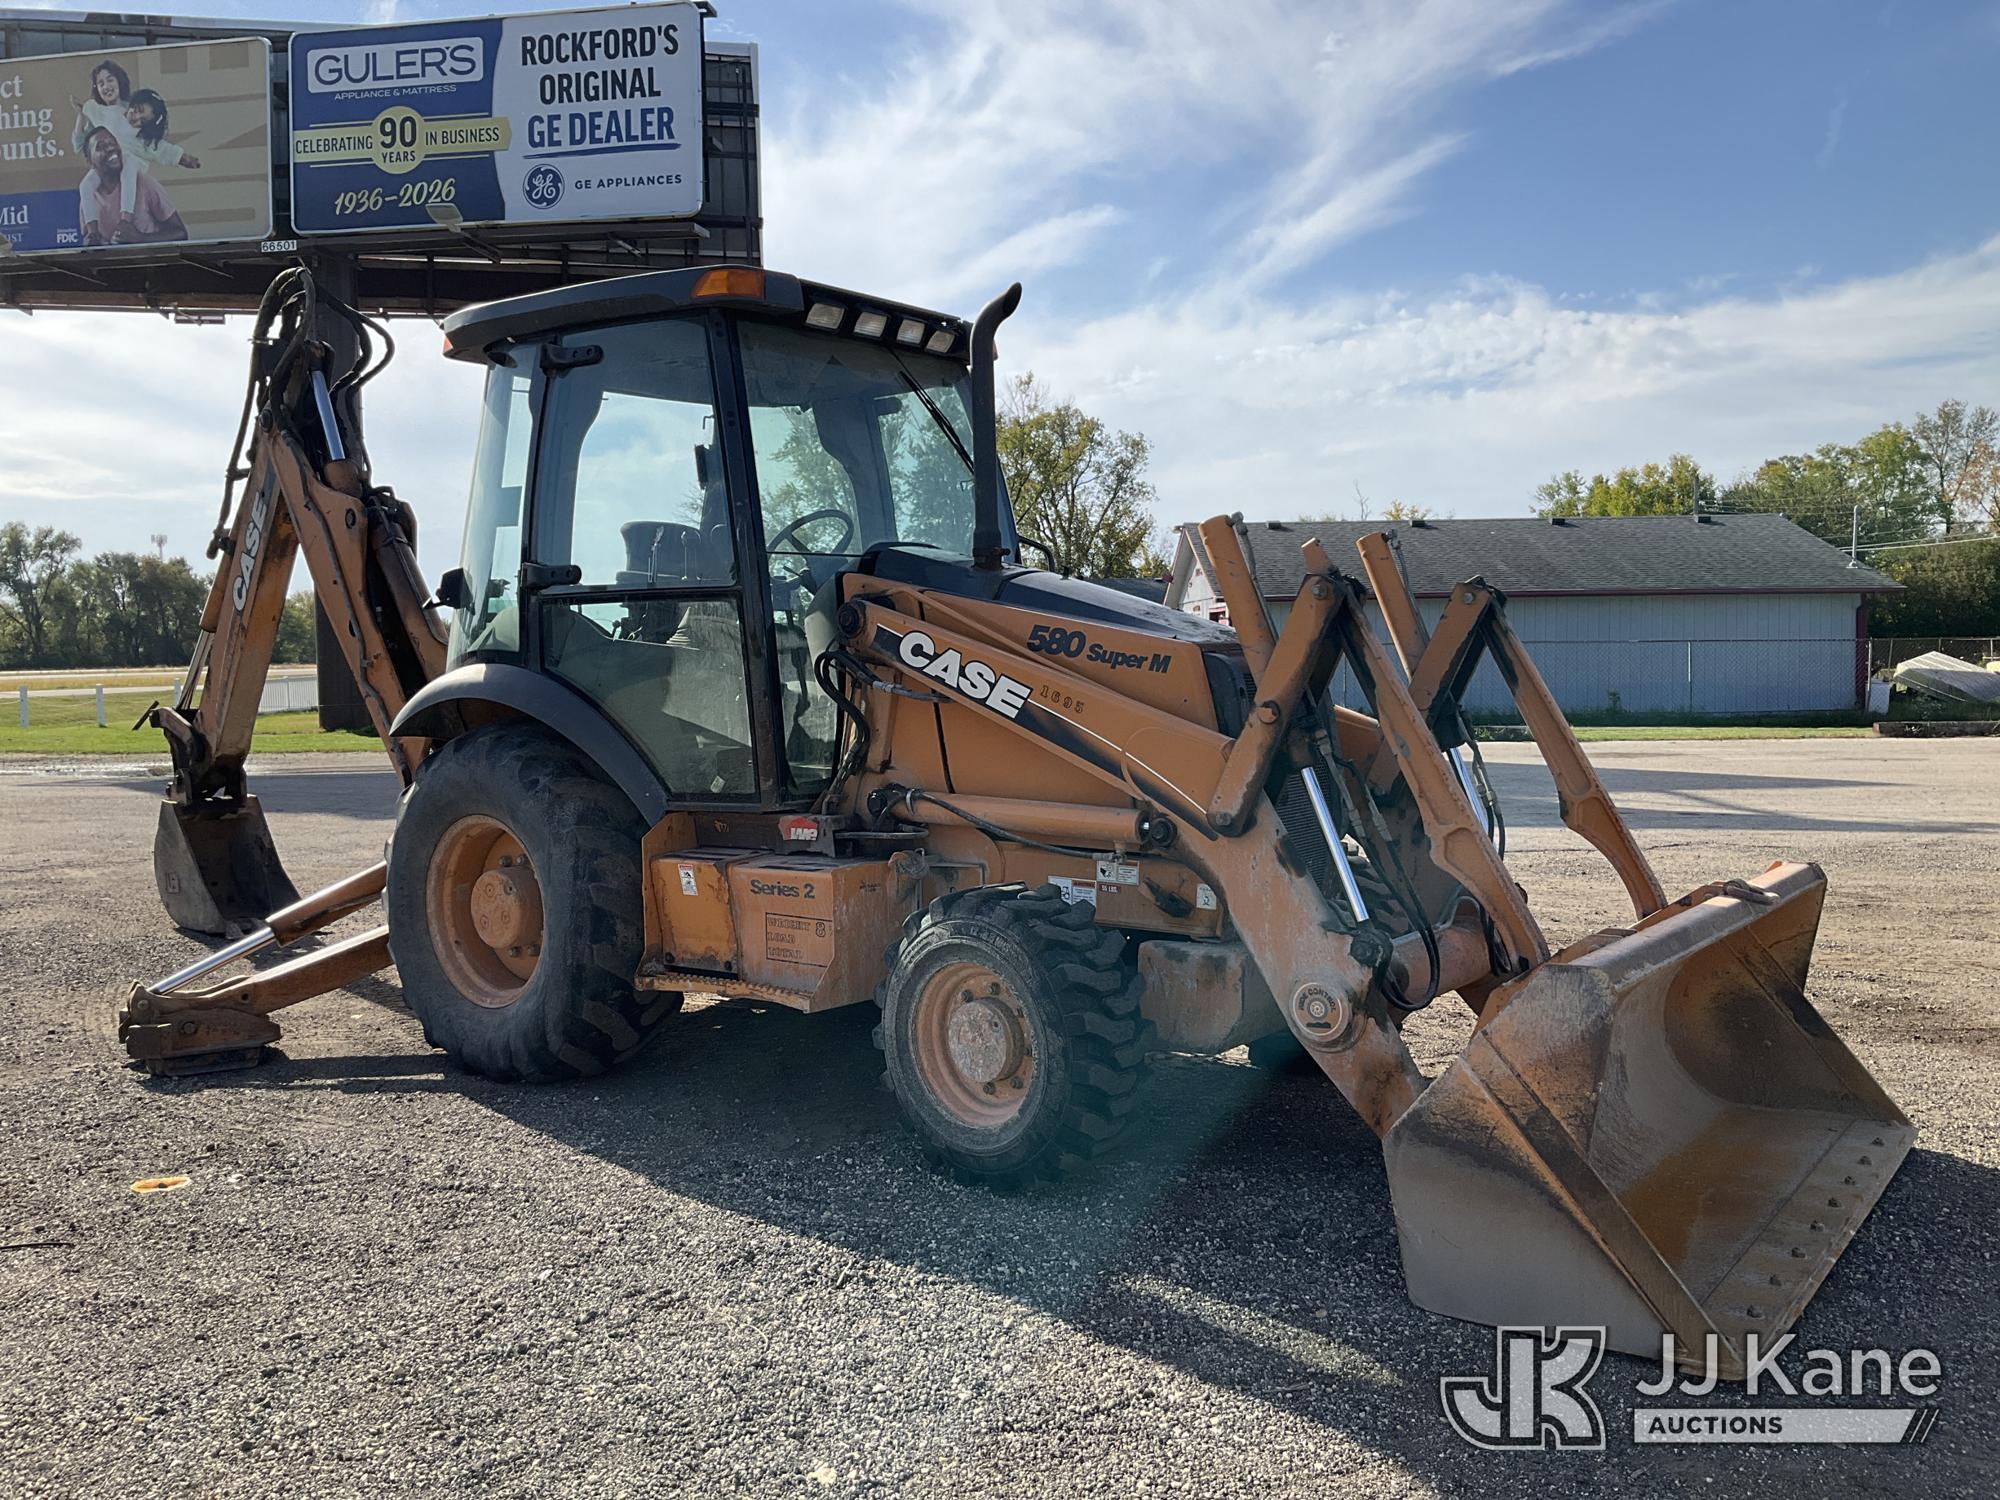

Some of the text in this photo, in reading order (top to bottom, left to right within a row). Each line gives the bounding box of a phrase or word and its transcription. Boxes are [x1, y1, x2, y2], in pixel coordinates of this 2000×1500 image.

[521, 24, 679, 66] ROCKFORD'S
[314, 44, 476, 85] GULER'S
[334, 89, 391, 100] APPLIANCE
[402, 84, 457, 95] MATTRESS
[539, 67, 661, 105] ORIGINAL
[295, 127, 500, 154] CELEBRATING IN BUSINESS
[379, 116, 417, 149] 90
[528, 106, 675, 149] GE DEALER
[381, 150, 416, 164] YEARS
[574, 174, 682, 190] GE APPLIANCES
[56, 232, 79, 244] FDIC
[262, 240, 295, 252] 66501
[232, 491, 268, 611] CASE
[1026, 624, 1172, 674] 580 Super M
[899, 630, 1034, 719] CASE
[1040, 684, 1085, 714] 1695
[750, 879, 816, 899] Series 2
